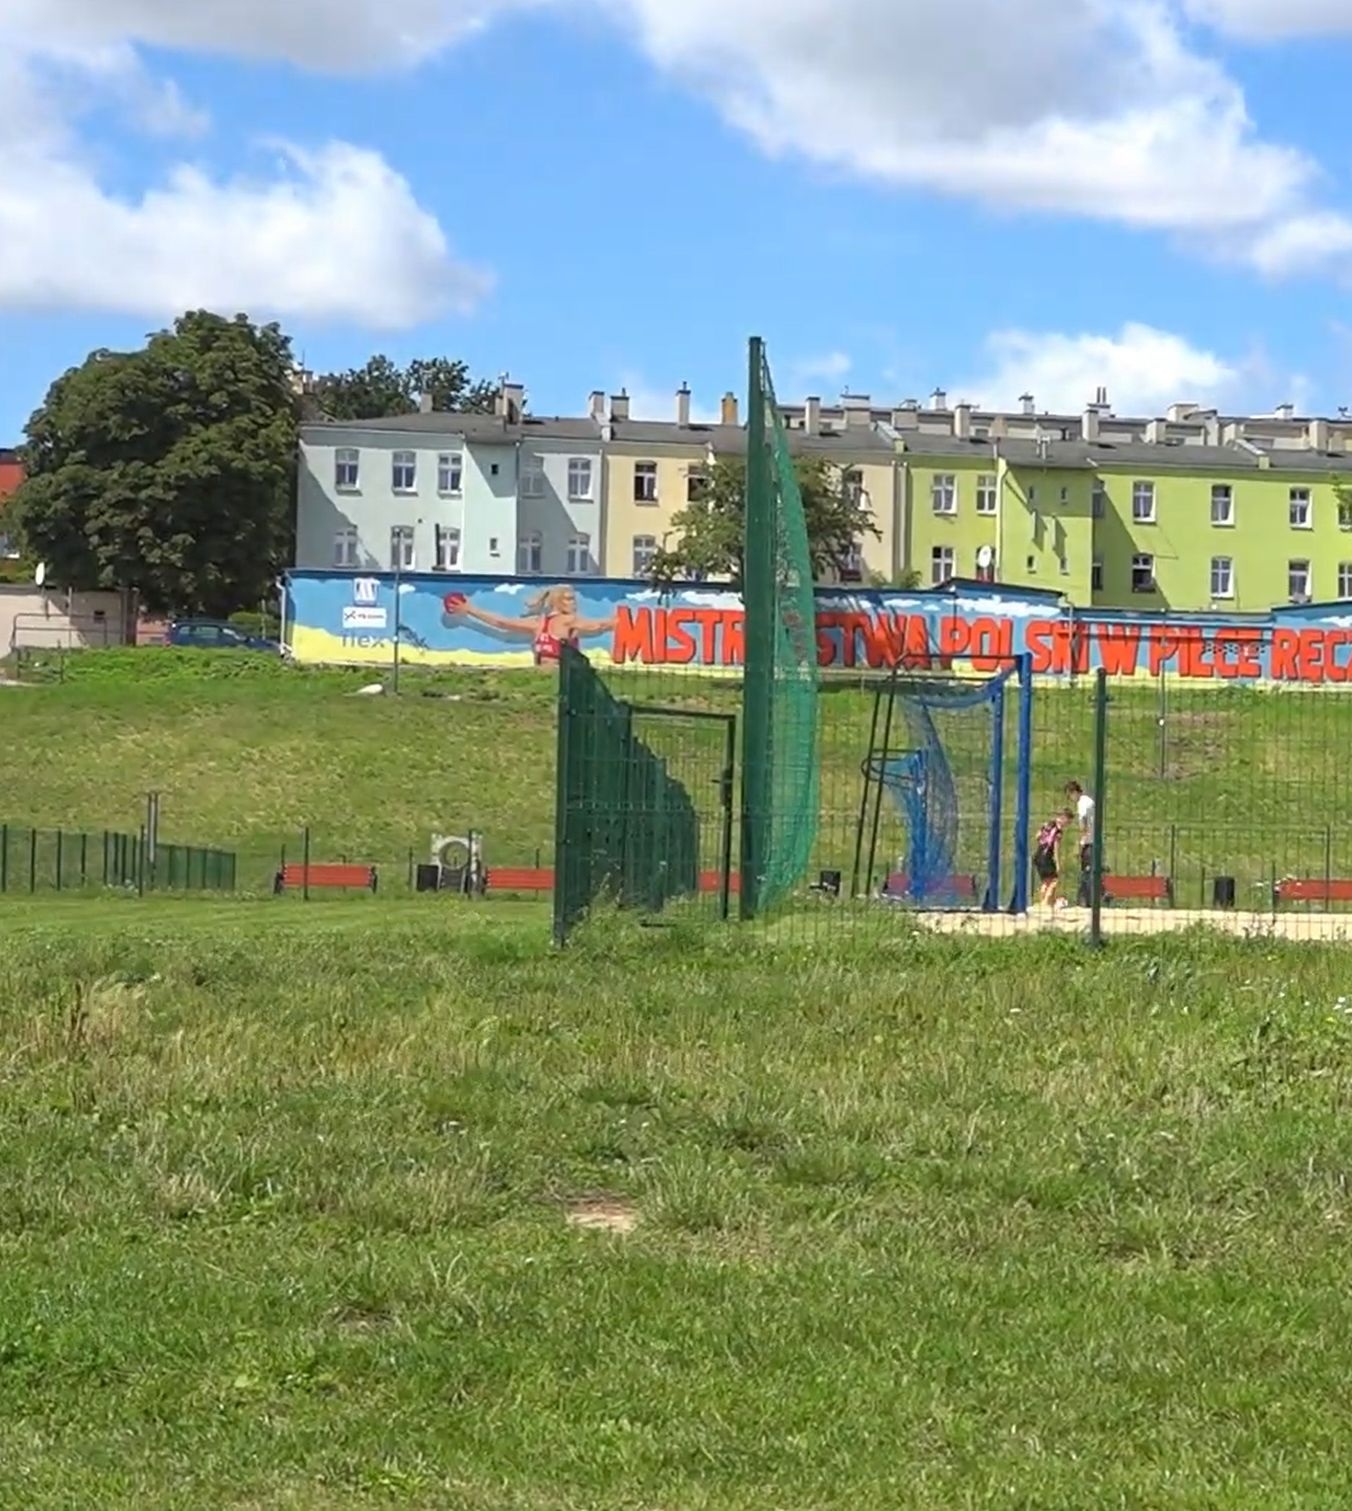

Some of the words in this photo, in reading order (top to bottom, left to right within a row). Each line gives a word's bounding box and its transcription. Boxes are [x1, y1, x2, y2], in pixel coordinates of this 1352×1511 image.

[613, 605, 931, 670] MISTRSTWA
[939, 615, 1090, 675] POLSKI
[1096, 620, 1141, 677] W
